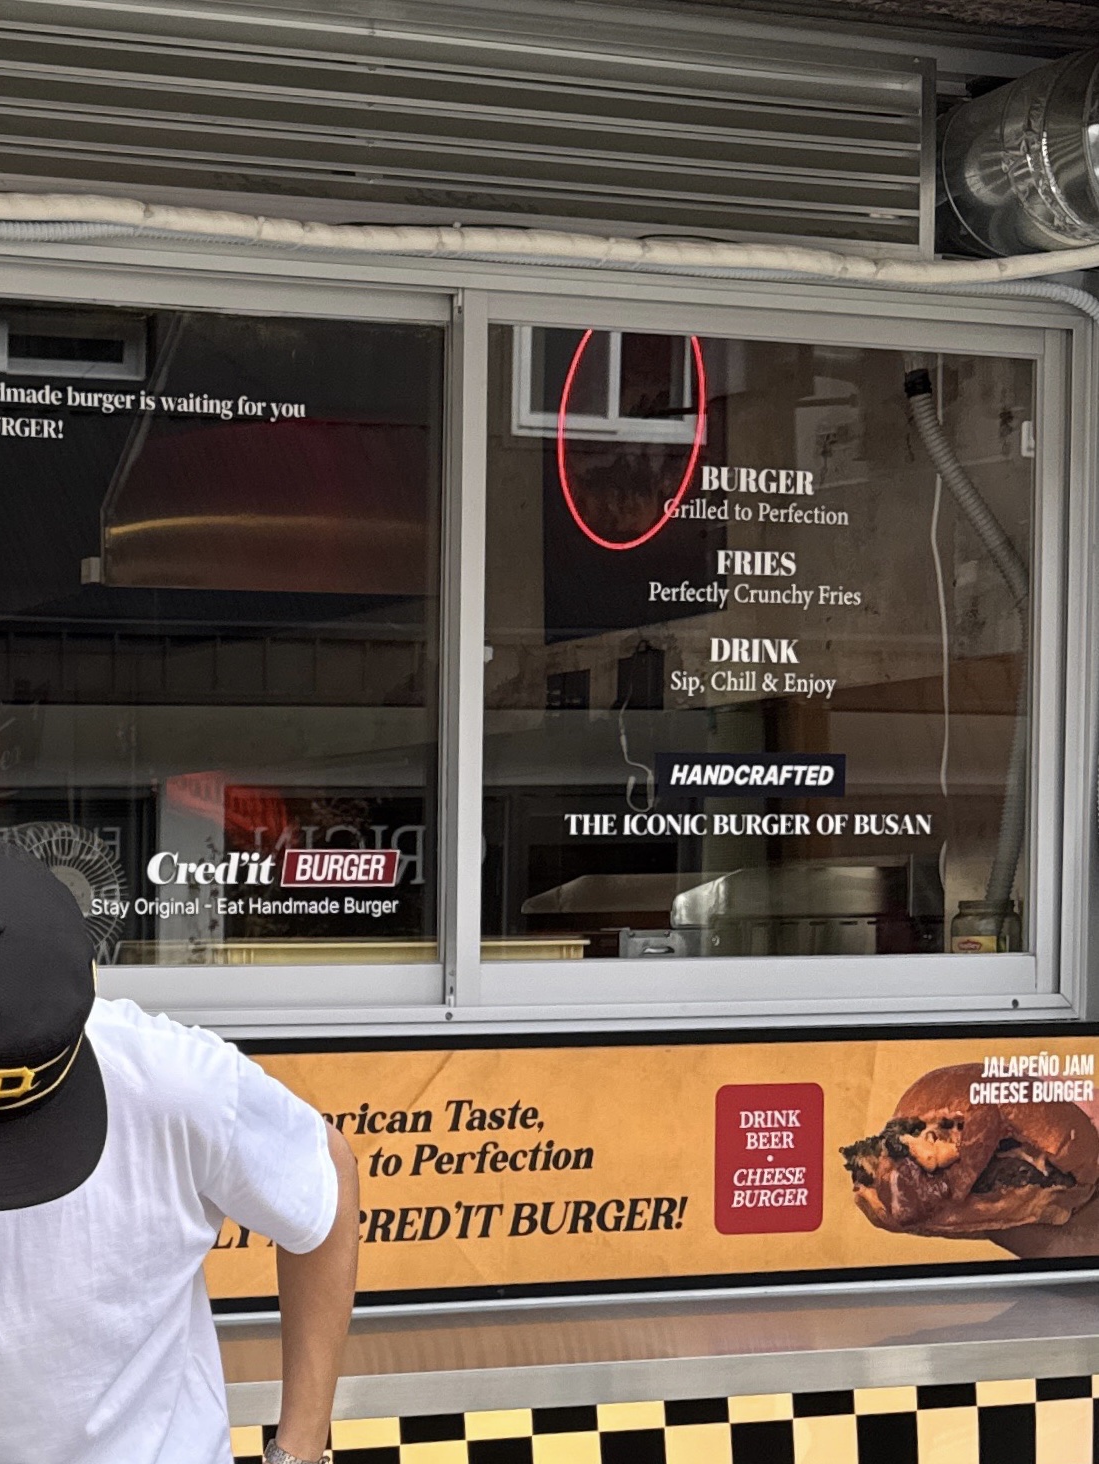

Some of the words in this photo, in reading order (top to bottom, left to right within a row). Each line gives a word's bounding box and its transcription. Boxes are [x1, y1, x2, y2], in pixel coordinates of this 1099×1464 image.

[68, 387, 135, 413] burger
[140, 391, 155, 410] is
[161, 394, 233, 419] waiting
[238, 396, 266, 418] for
[271, 399, 305, 422] you
[702, 466, 814, 495] BURGER
[664, 499, 729, 522] Grilled
[735, 504, 752, 520] to
[759, 503, 848, 525] Perfection
[718, 551, 796, 576] FRIES
[649, 581, 730, 608] Perfectly
[734, 584, 813, 610] Crunchy
[819, 586, 861, 605] Fries
[711, 638, 798, 663] DRINK
[671, 671, 704, 696] Sip,
[711, 671, 756, 691] Chill
[762, 673, 778, 691] &
[784, 673, 836, 698] Enjoy
[671, 765, 834, 785] HANDCRAFTED
[565, 815, 616, 835] THE
[624, 814, 707, 835] ICONIC
[714, 814, 810, 835] BURGER
[817, 815, 848, 834] OF
[855, 815, 930, 835] BUSAN
[147, 852, 275, 884] Cred'it
[296, 854, 385, 881] BURGER
[91, 897, 129, 918] Stay
[135, 897, 199, 919] Original
[217, 897, 244, 914] Eat
[249, 898, 339, 914] Handmade
[345, 897, 398, 917] Burger
[982, 1052, 1059, 1077] JALAPEÑO
[1063, 1055, 1094, 1076] JAM
[970, 1082, 1029, 1104] CHEESE
[1033, 1080, 1094, 1102] BURGER
[446, 1100, 543, 1132] Taste,
[740, 1110, 800, 1128] DRINK
[746, 1132, 794, 1149] BEER
[370, 1147, 402, 1177] to
[410, 1140, 593, 1176] Perfection
[734, 1168, 805, 1186] CHEESE
[732, 1189, 808, 1207] BURGER
[508, 1197, 688, 1236] BURGER!
